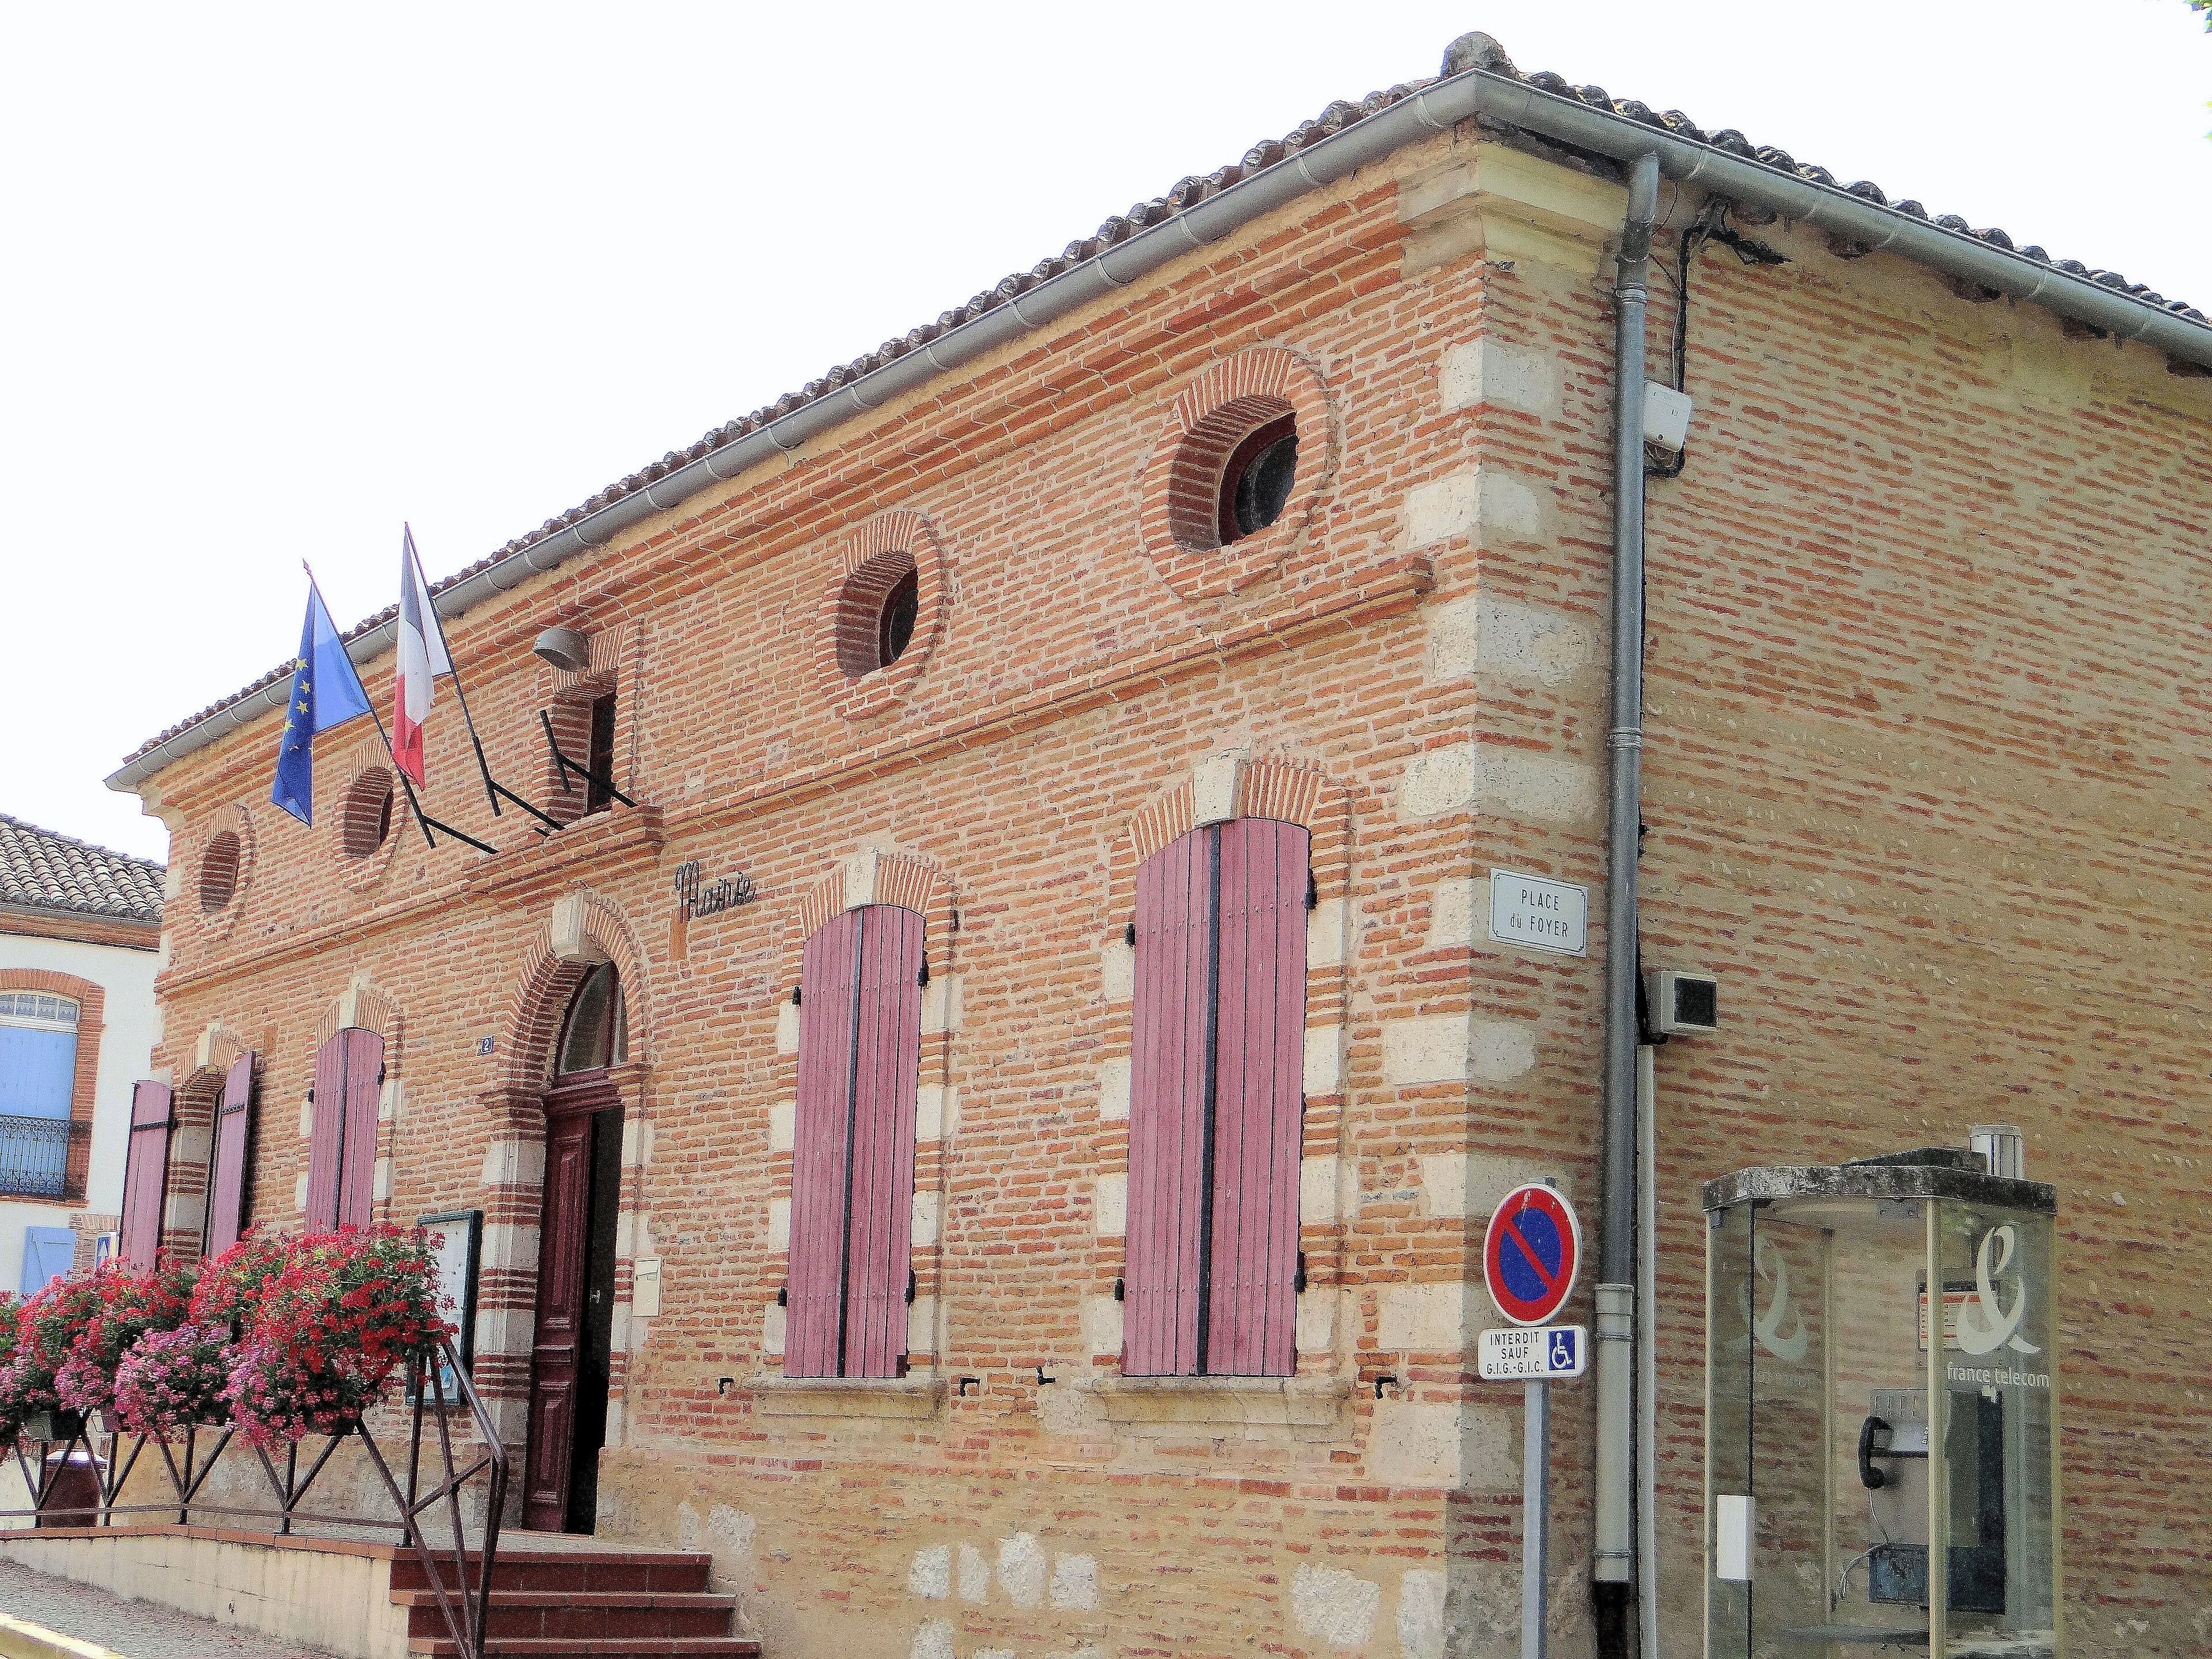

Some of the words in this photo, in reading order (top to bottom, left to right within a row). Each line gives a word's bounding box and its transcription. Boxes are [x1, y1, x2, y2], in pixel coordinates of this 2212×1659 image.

[675, 860, 756, 923] Mairie
[1521, 889, 1559, 911] PLACE
[1510, 912, 1521, 929] du
[1529, 916, 1568, 937] FOYER
[484, 1039, 489, 1051] 2
[1490, 1331, 1539, 1346] INTERDIT
[1501, 1347, 1529, 1359] SAUF
[1946, 1360, 1990, 1383] france
